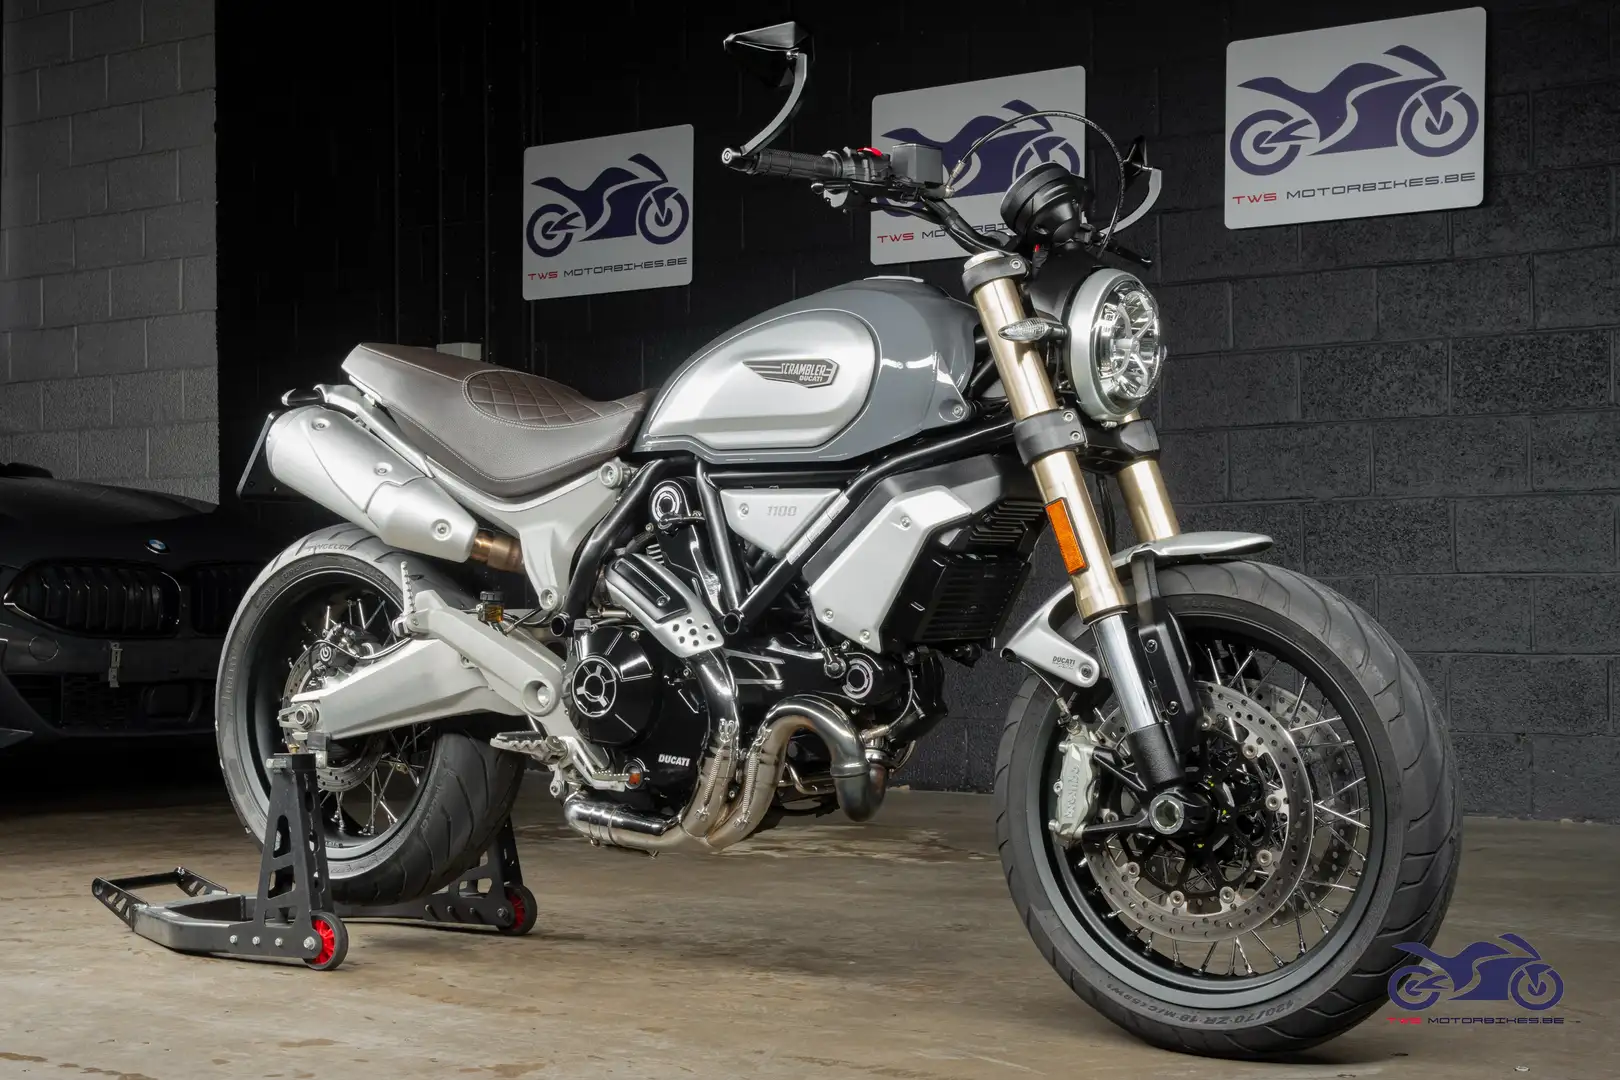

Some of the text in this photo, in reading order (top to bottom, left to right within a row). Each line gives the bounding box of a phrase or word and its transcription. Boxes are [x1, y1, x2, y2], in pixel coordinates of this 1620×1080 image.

[1232, 172, 1476, 205] TWS MOTORBIKES.BE
[877, 232, 914, 243] TWS
[527, 257, 688, 281] TWS MOTORBIKES.BE
[781, 363, 826, 376] SCRAMBLER
[767, 505, 797, 517] 1100
[1052, 655, 1076, 665] DUCATI
[658, 753, 691, 767] DUCATI
